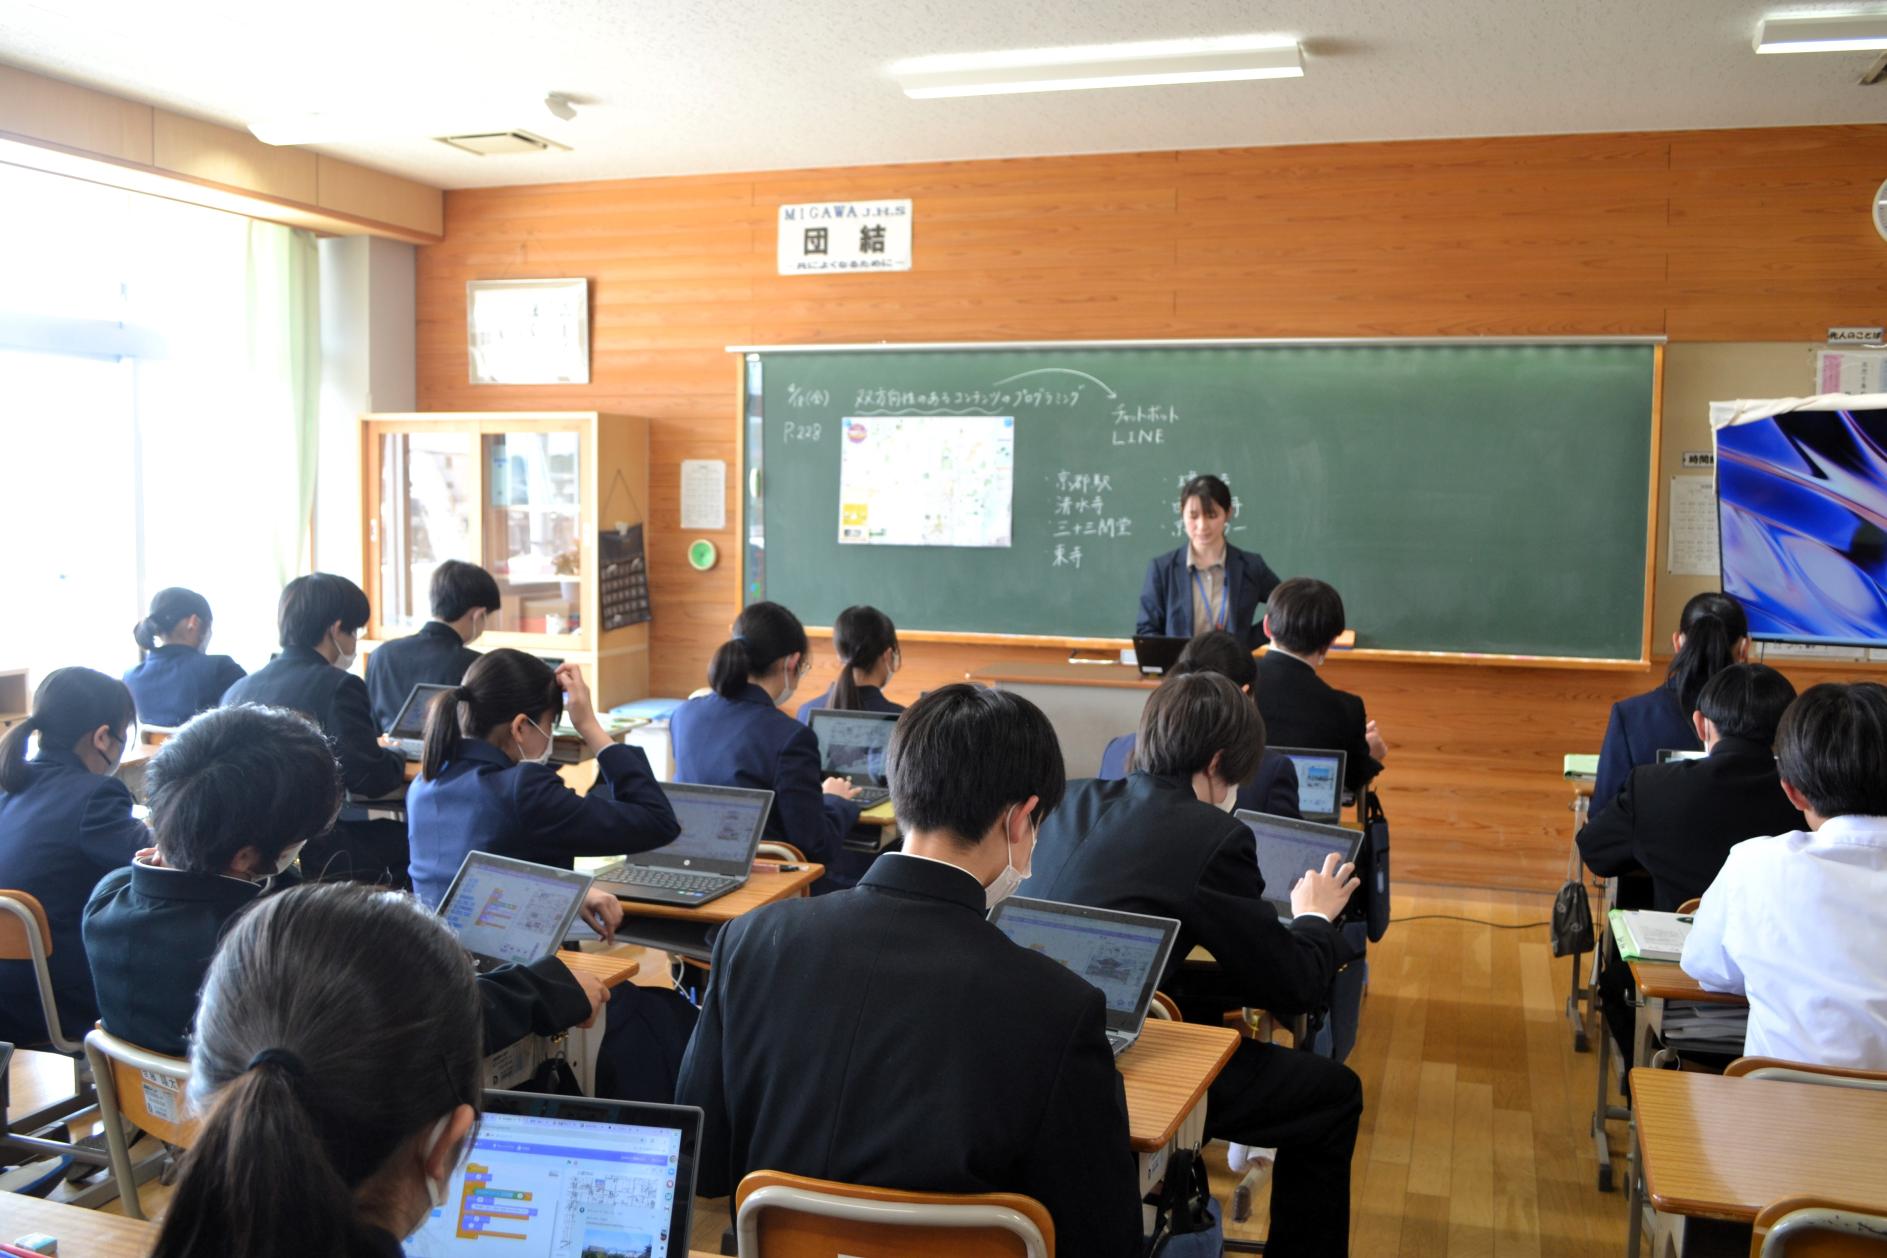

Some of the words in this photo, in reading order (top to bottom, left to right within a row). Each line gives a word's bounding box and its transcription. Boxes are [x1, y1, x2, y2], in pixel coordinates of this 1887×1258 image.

[785, 205, 857, 220] MIGAWA
[804, 224, 886, 255] 団結
[1112, 428, 1164, 445] LINE
[1054, 496, 1104, 515] 清水寺
